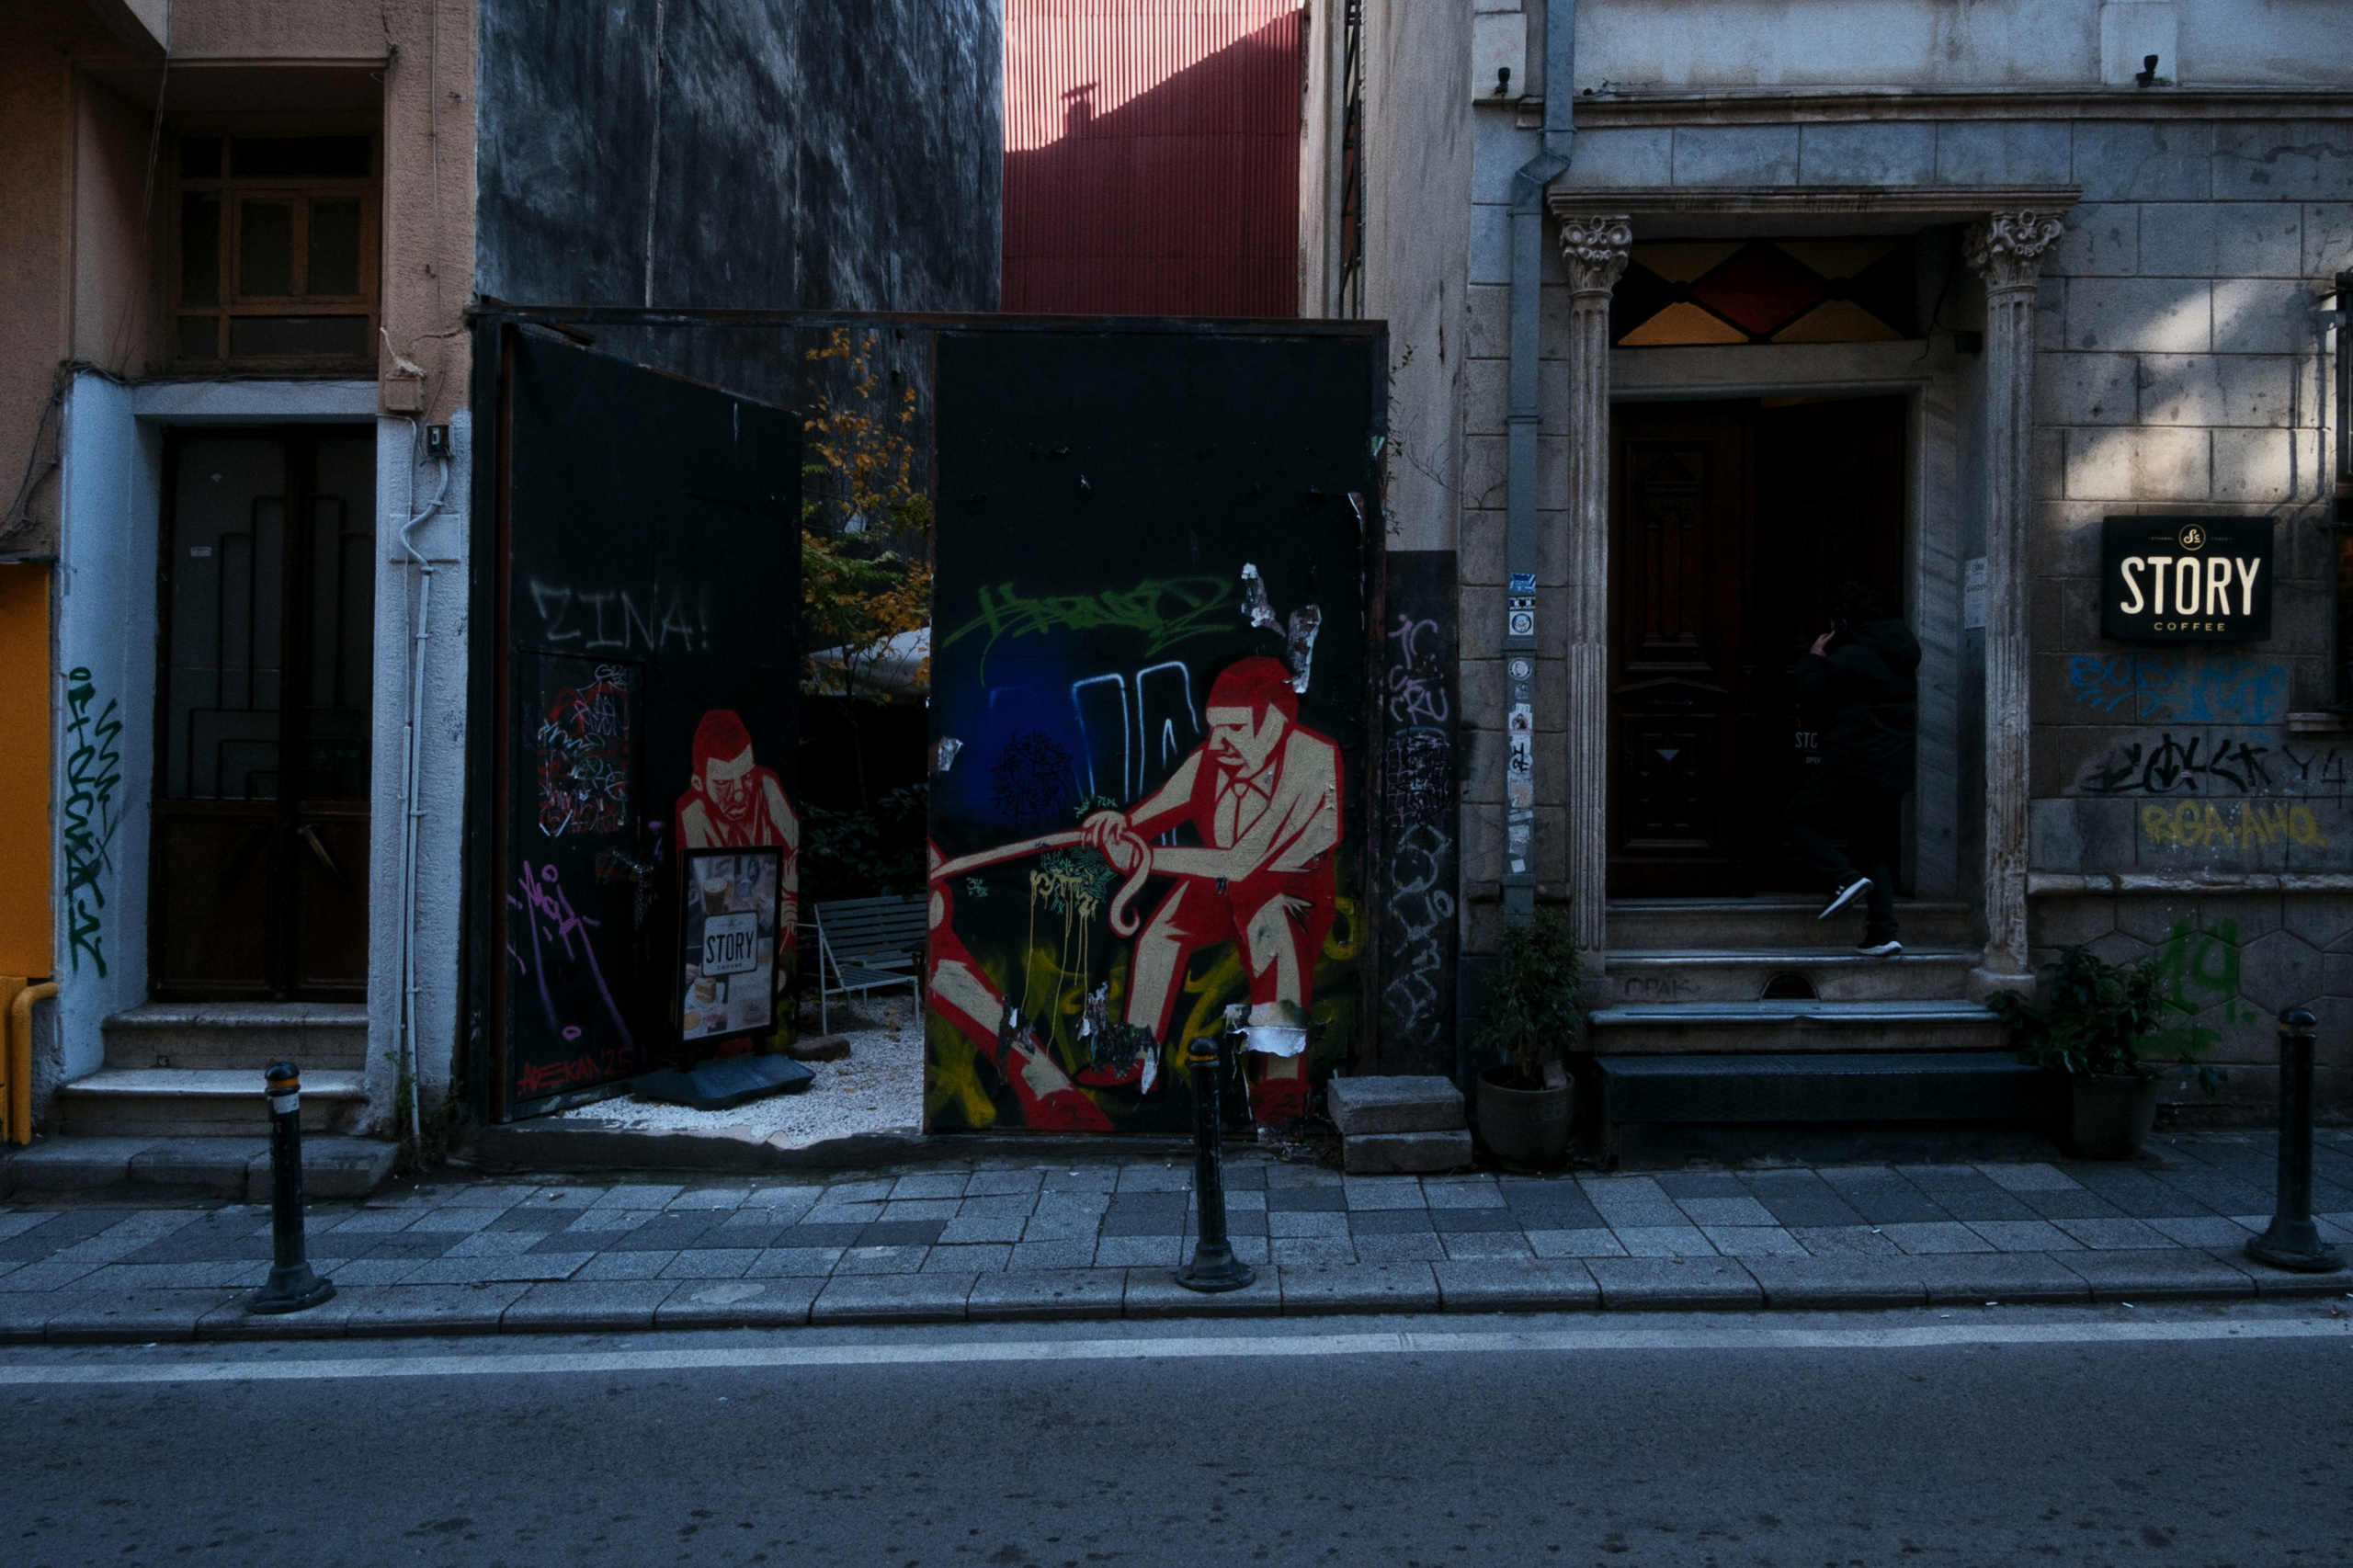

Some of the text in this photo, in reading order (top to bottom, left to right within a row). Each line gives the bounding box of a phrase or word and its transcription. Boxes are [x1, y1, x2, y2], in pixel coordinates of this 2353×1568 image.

[2120, 556, 2261, 616] STORY
[2154, 622, 2226, 632] COFFEE
[706, 930, 755, 964] STORY
